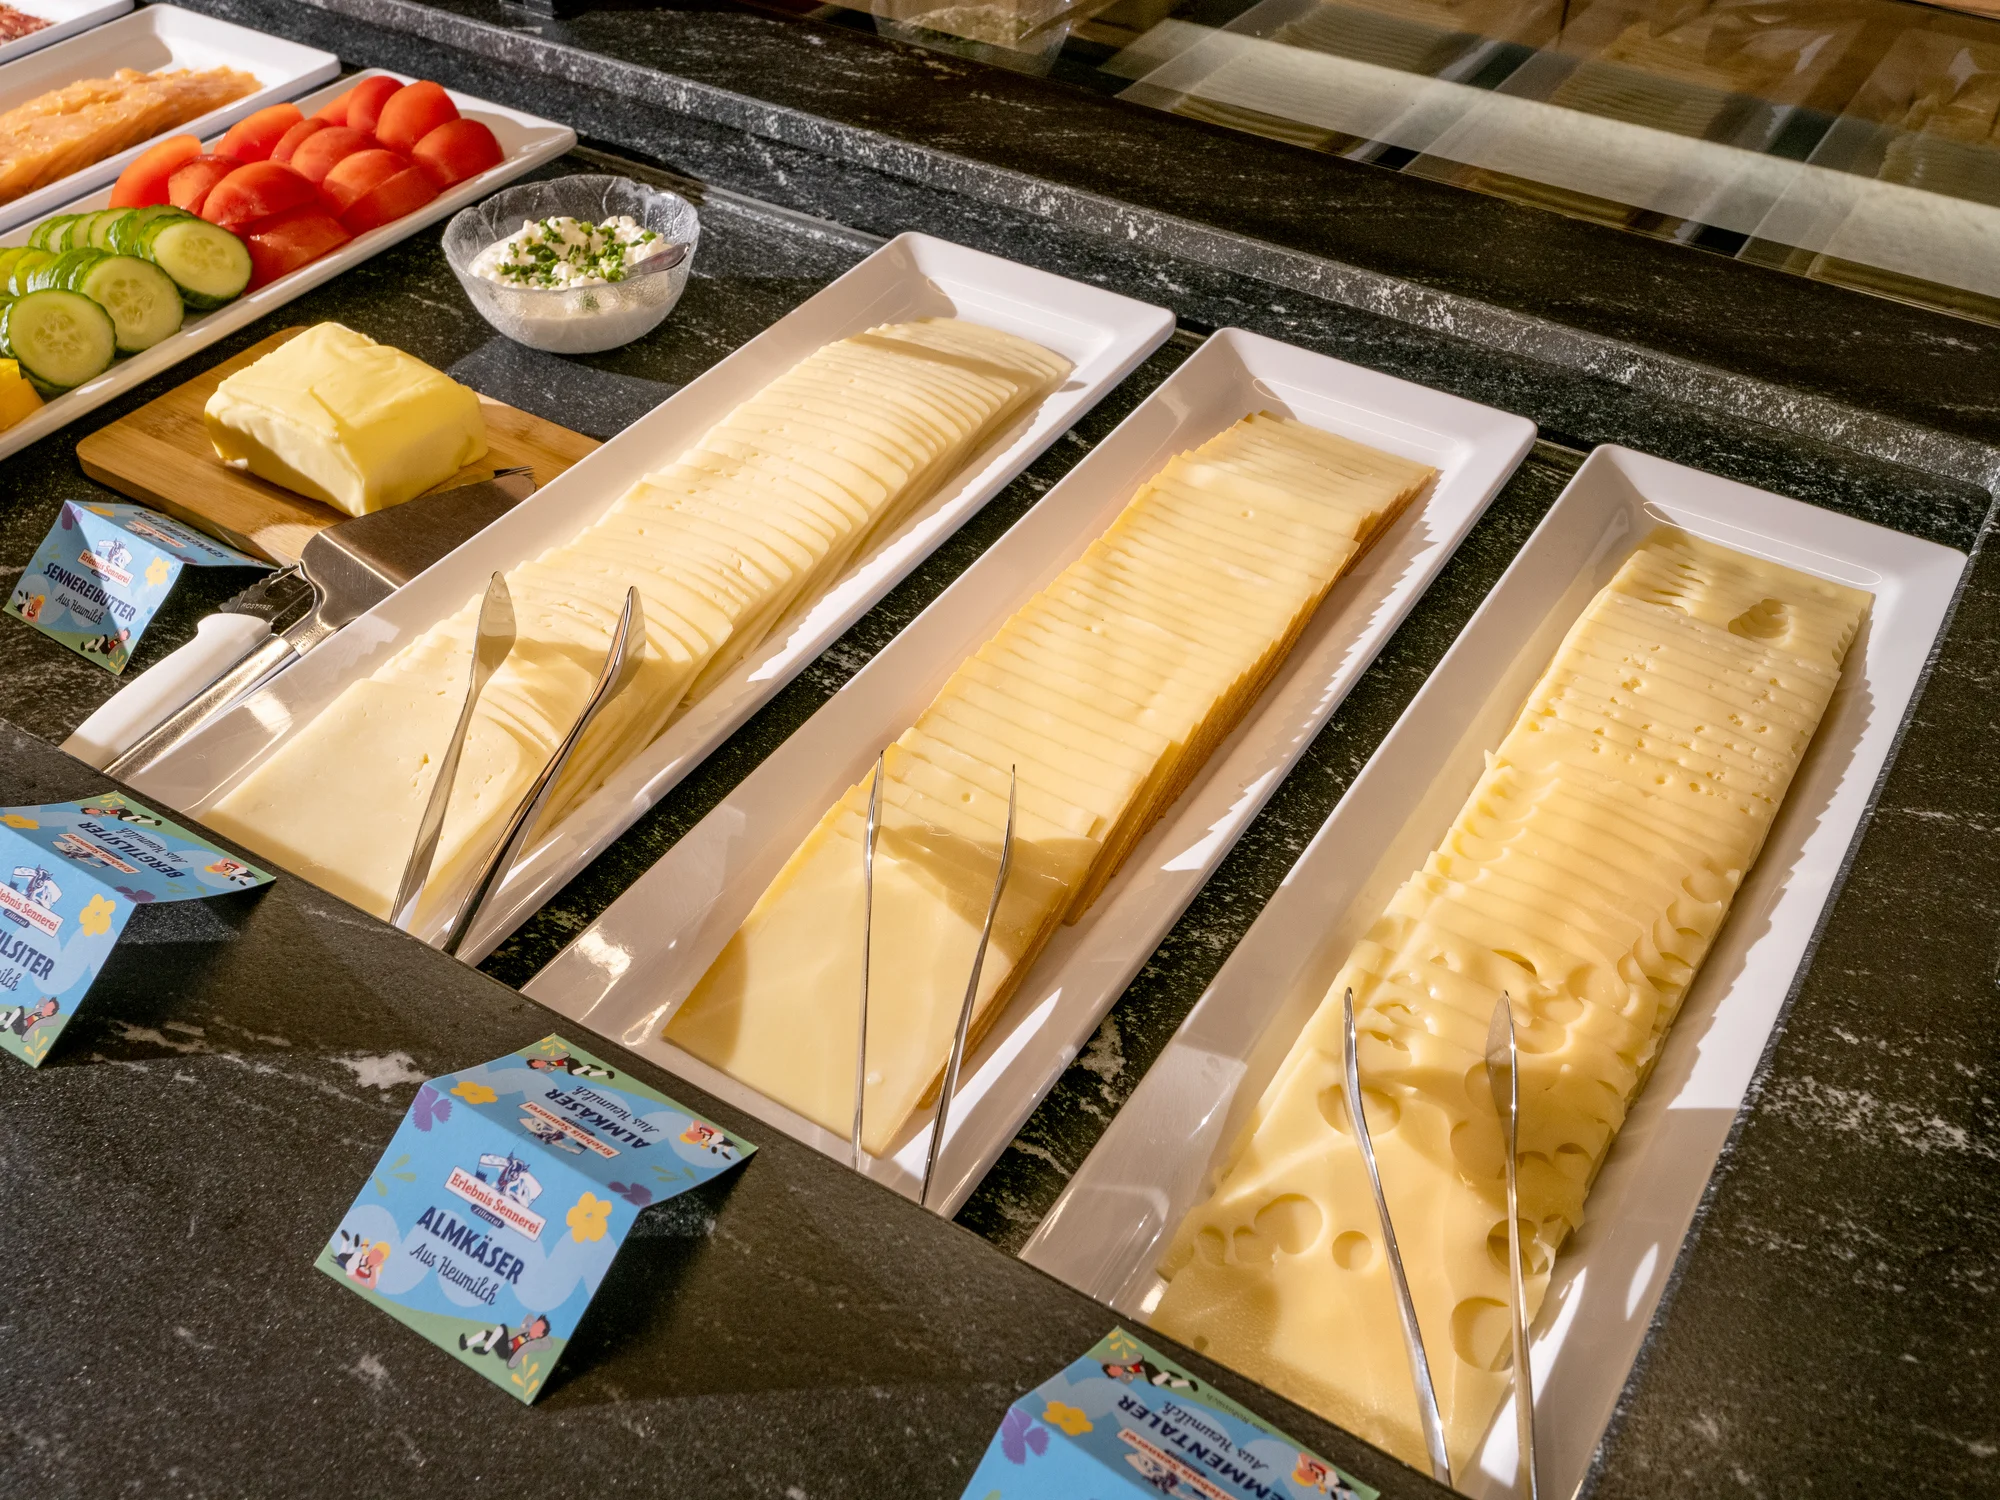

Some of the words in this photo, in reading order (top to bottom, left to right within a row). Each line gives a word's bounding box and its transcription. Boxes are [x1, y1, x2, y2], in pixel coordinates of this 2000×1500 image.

[80, 552, 106, 573] Erlebnis
[104, 564, 131, 584] Sennerei
[43, 562, 137, 622] SENNEREIBUTTER
[240, 602, 274, 611] ROSTFREI
[55, 593, 70, 607] Aus
[70, 599, 103, 626] Heumilch
[78, 821, 186, 879] BERGTILSITER
[115, 827, 167, 853] Heumilch
[163, 851, 188, 863] Aus
[21, 903, 59, 932] Sennerei
[0, 927, 55, 981] ILSITER
[0, 967, 22, 992] ilch
[524, 1103, 571, 1133] Sennerei
[544, 1088, 652, 1149] ALMKÄSER
[571, 1085, 632, 1122] Heumilch
[631, 1117, 660, 1133] Aus
[569, 1129, 615, 1157] Erlebnis
[450, 1173, 493, 1209] Erlebnis
[491, 1198, 542, 1236] Sennerei
[416, 1205, 525, 1285] ALMKÄSER
[409, 1242, 437, 1268] Aus
[437, 1256, 500, 1307] Heumilch
[1162, 1400, 1233, 1453] Heumilch
[1237, 1448, 1269, 1470] Aus
